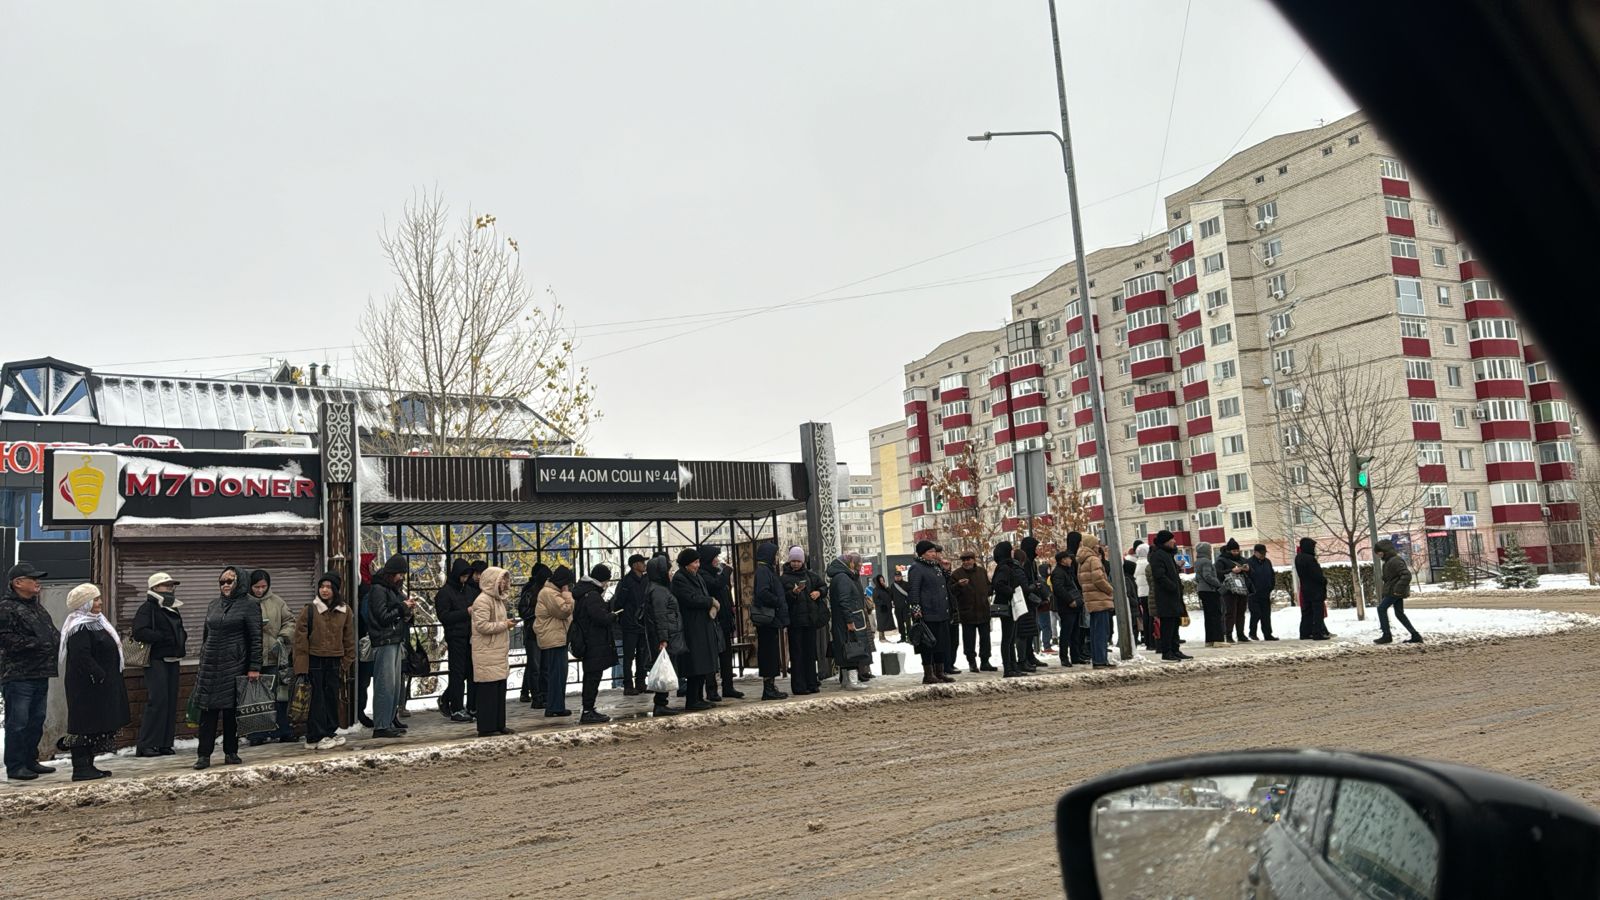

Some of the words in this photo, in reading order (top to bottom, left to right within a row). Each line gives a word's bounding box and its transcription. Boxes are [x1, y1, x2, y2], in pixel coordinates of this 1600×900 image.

[559, 469, 575, 482] 44
[579, 469, 608, 482] АОМ
[611, 470, 642, 483] СОШ
[662, 470, 677, 482] 44
[126, 473, 187, 497] M7
[191, 477, 315, 498] DONER
[241, 704, 273, 714] CLASSIC
